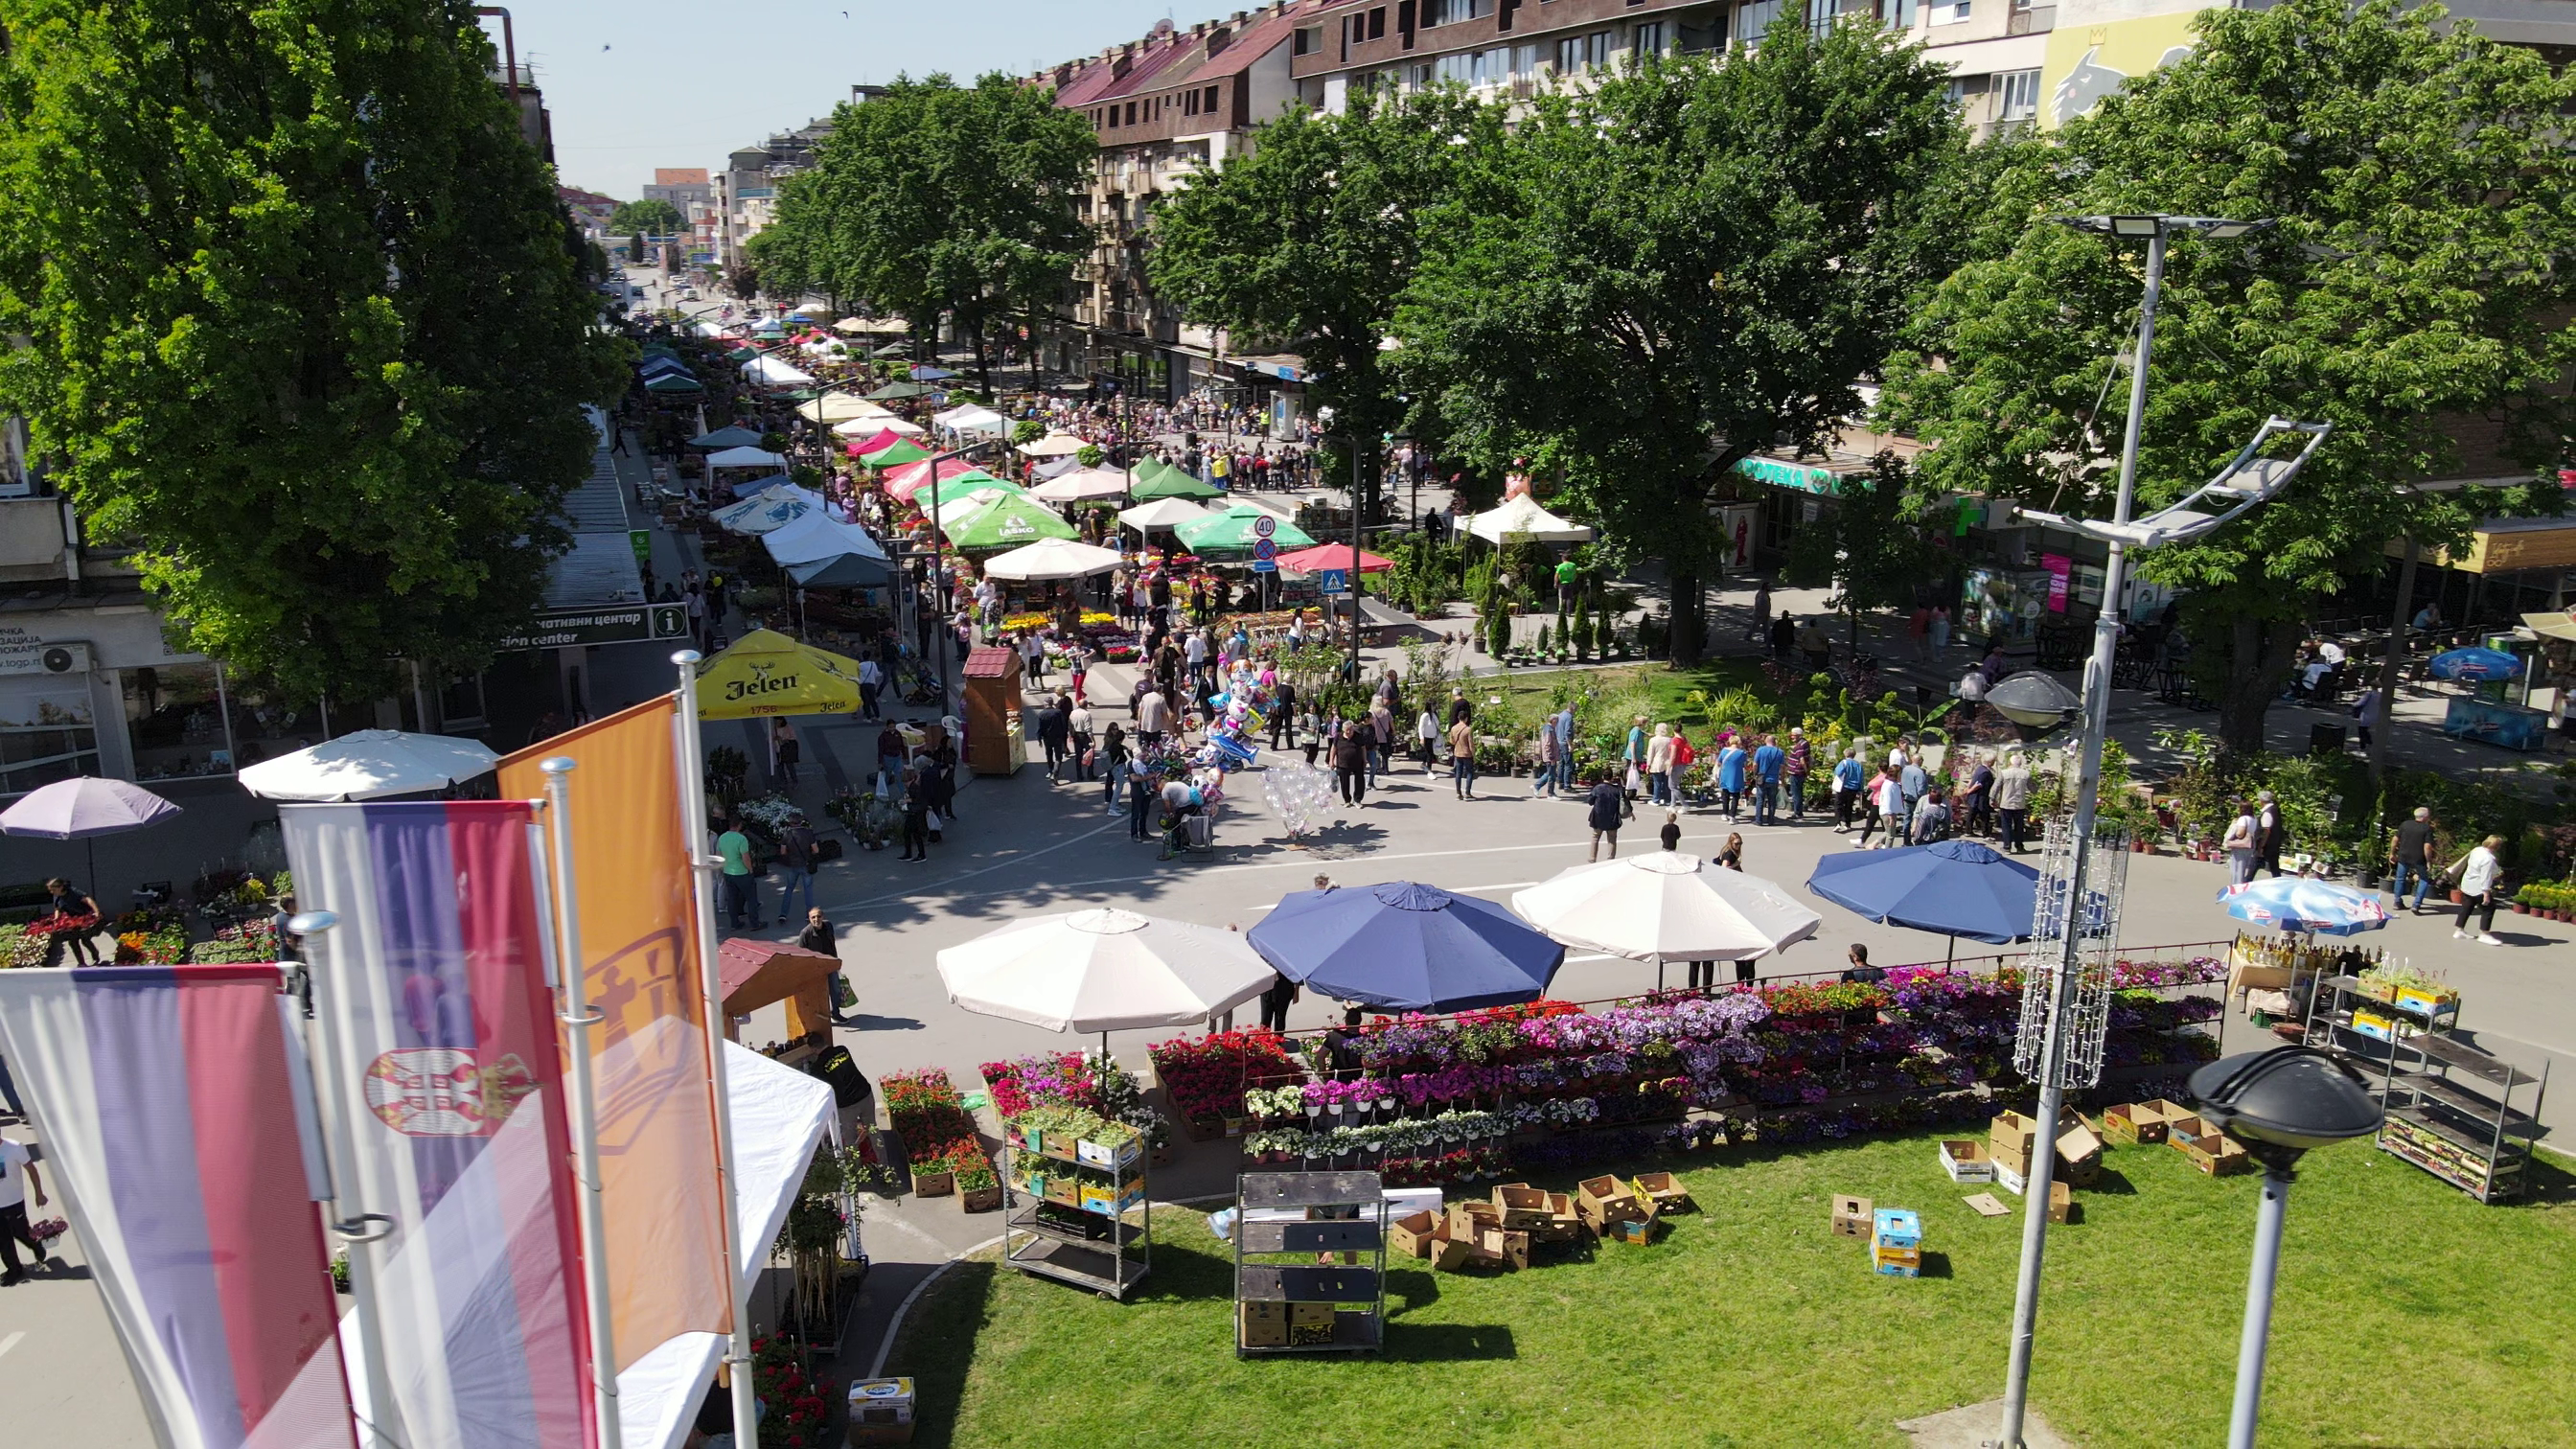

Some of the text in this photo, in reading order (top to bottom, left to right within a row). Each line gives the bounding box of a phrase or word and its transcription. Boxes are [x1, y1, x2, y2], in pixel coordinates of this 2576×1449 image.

[1258, 520, 1272, 532] 40
[594, 612, 641, 626] центар
[531, 632, 578, 646] center
[725, 674, 797, 701] Jelen
[750, 705, 778, 714] 1756
[820, 701, 846, 712] Jelen
